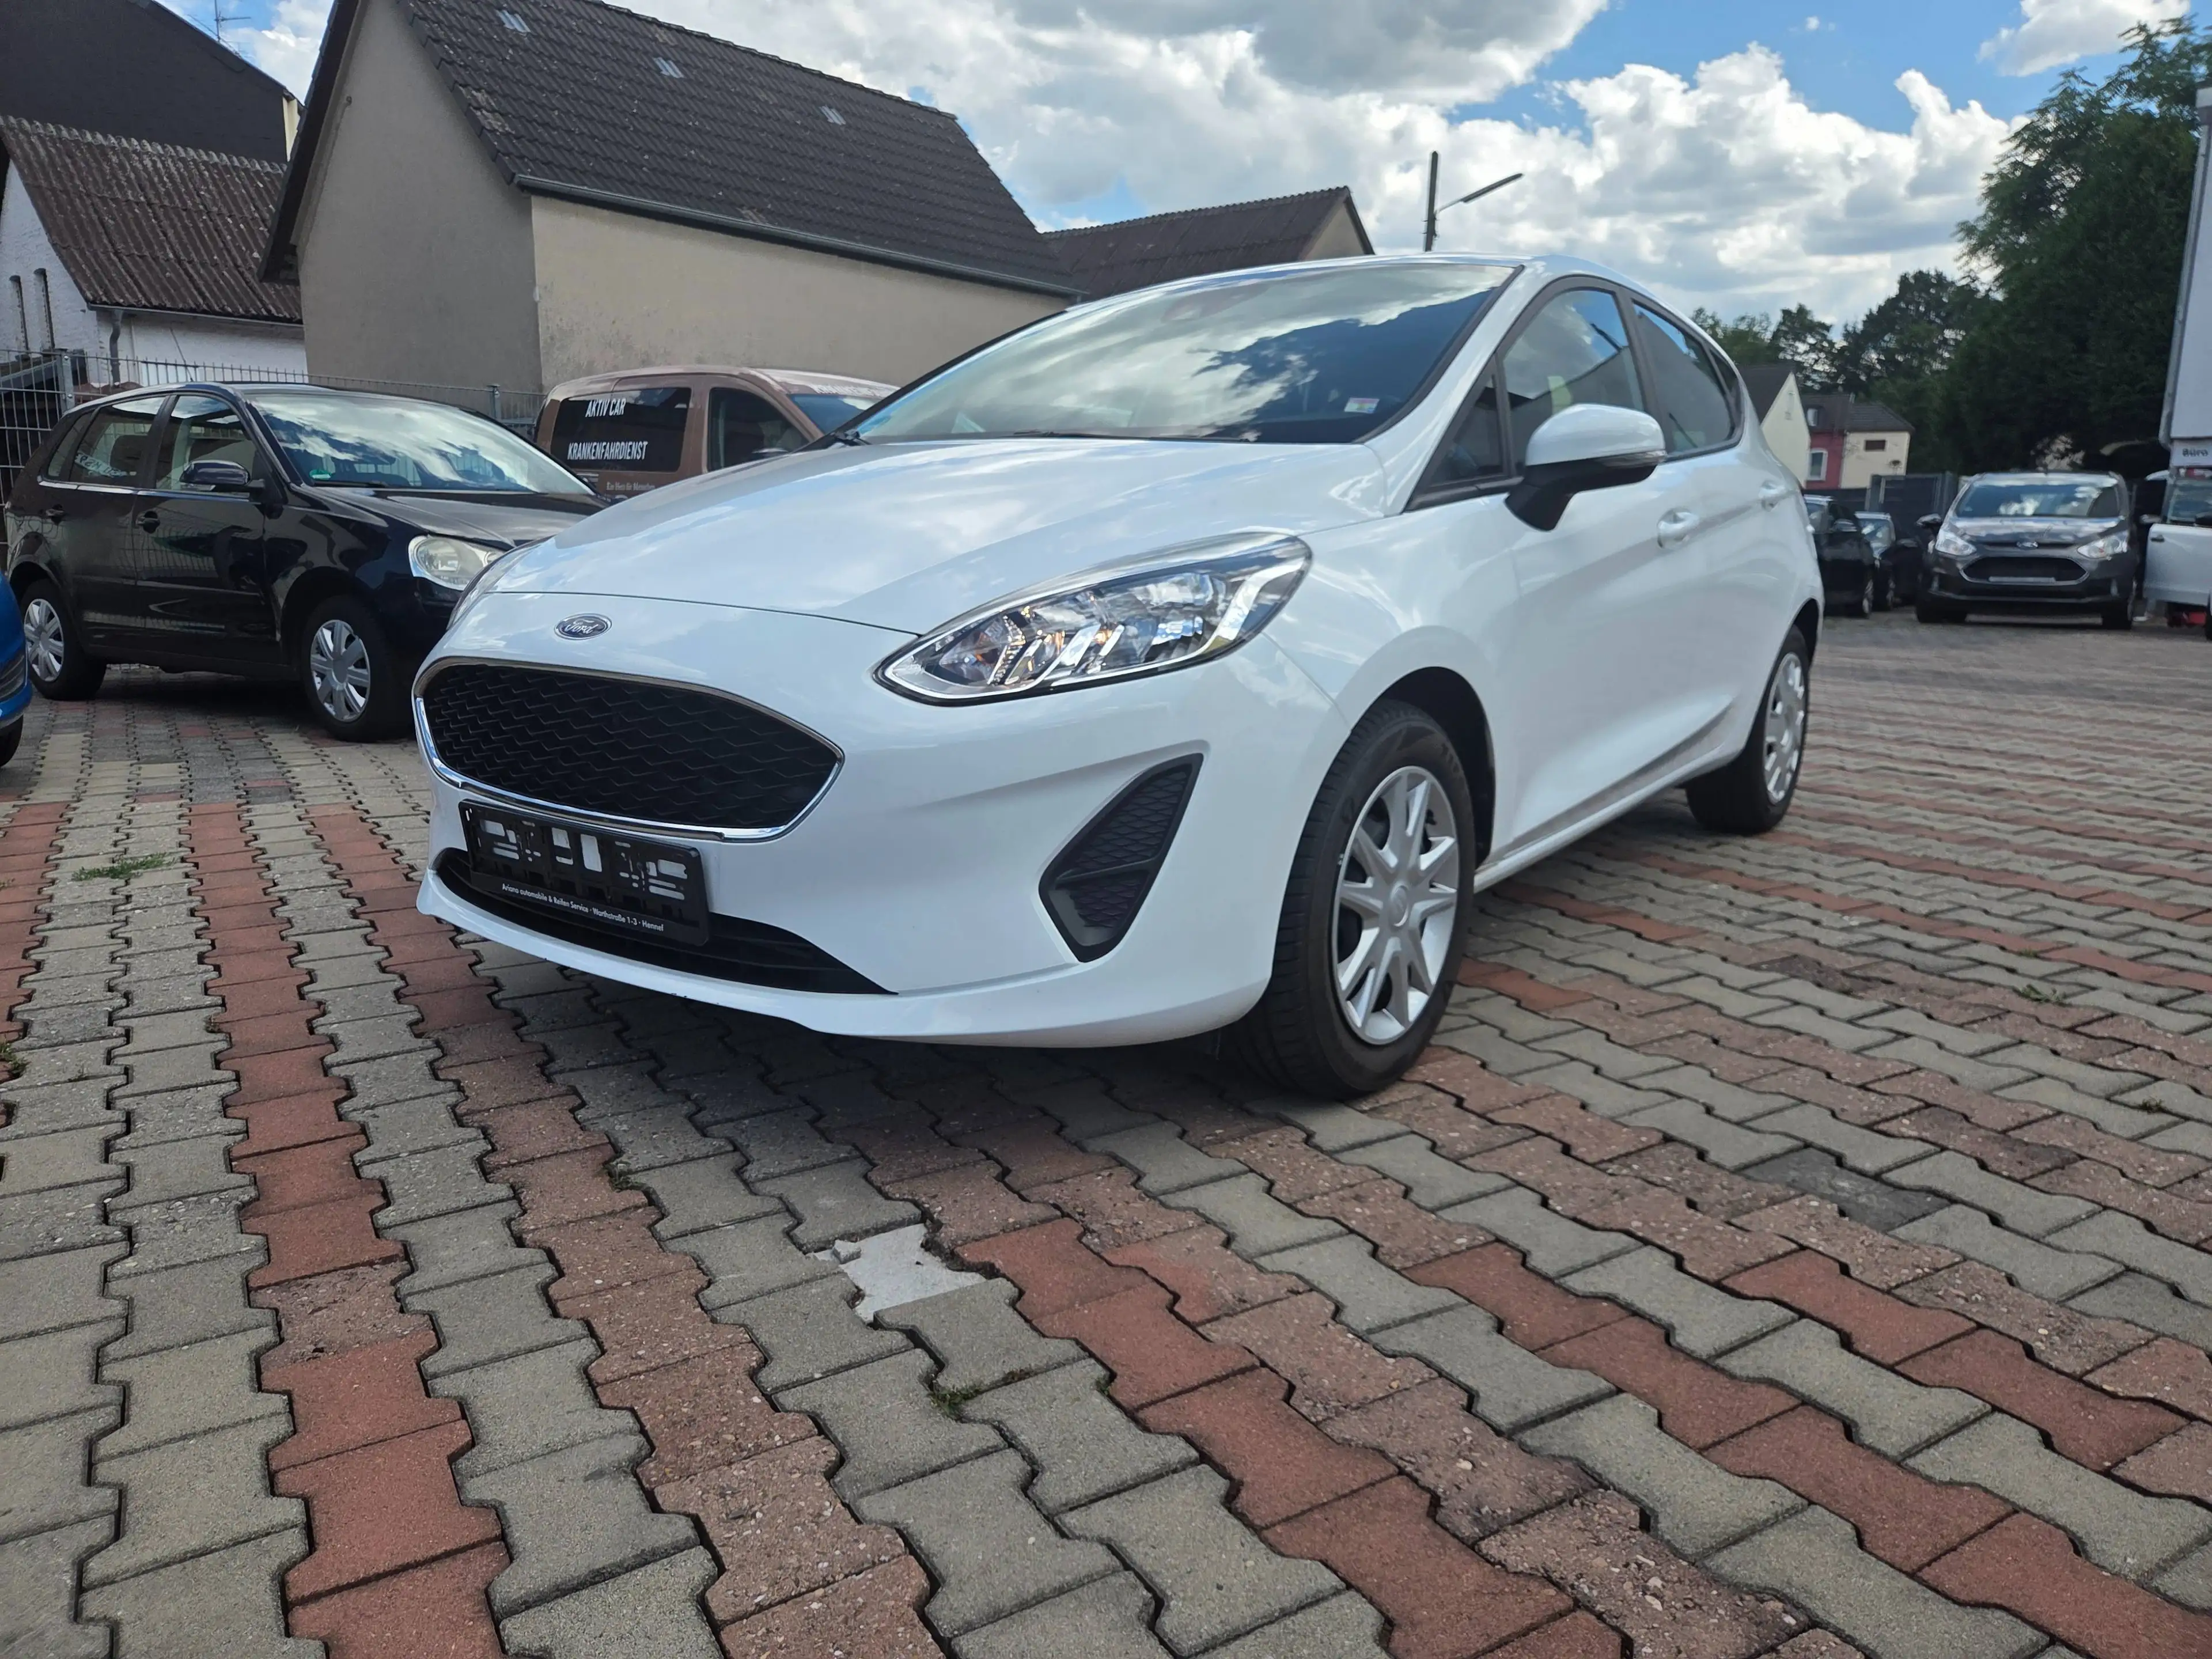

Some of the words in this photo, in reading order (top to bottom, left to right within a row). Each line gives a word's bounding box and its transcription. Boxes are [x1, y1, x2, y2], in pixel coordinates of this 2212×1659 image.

[585, 398, 609, 418] AKTIV
[609, 397, 626, 416] CAR
[567, 441, 649, 460] KRANKENFAHRDIENST
[565, 618, 599, 634] Ford
[520, 889, 547, 902] automobile
[553, 896, 570, 907] Reifen
[570, 901, 589, 912] Service
